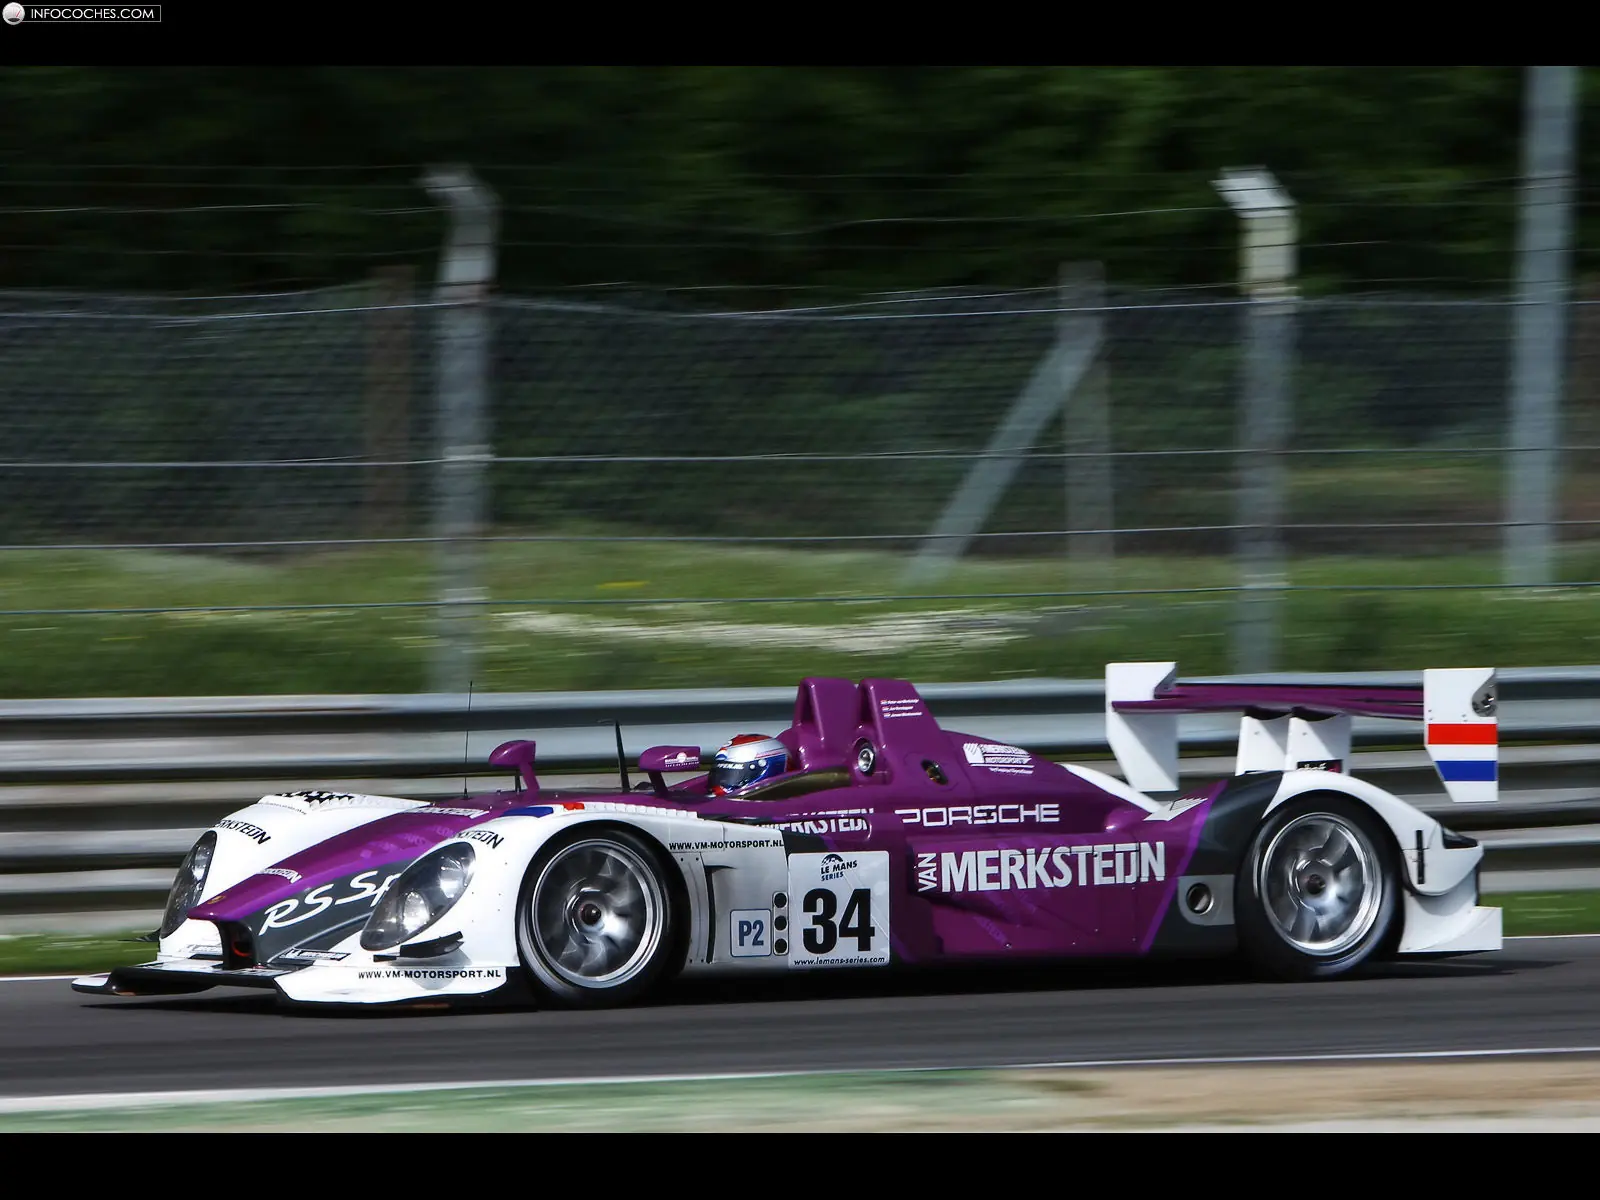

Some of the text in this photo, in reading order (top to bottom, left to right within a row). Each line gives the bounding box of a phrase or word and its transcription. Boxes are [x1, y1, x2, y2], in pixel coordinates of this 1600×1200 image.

[894, 804, 1060, 827] PORSCHE
[669, 840, 785, 850] WWW.VM-MOTORSPORT.NL
[820, 859, 858, 875] LE MANS
[917, 852, 937, 892] VAN
[821, 871, 844, 881] SERIES
[803, 888, 875, 954] 34
[738, 919, 764, 947] P2
[794, 955, 885, 966] www.lemans-series.com
[358, 970, 501, 980] WWW.VM-MOTORSPORT.NL
